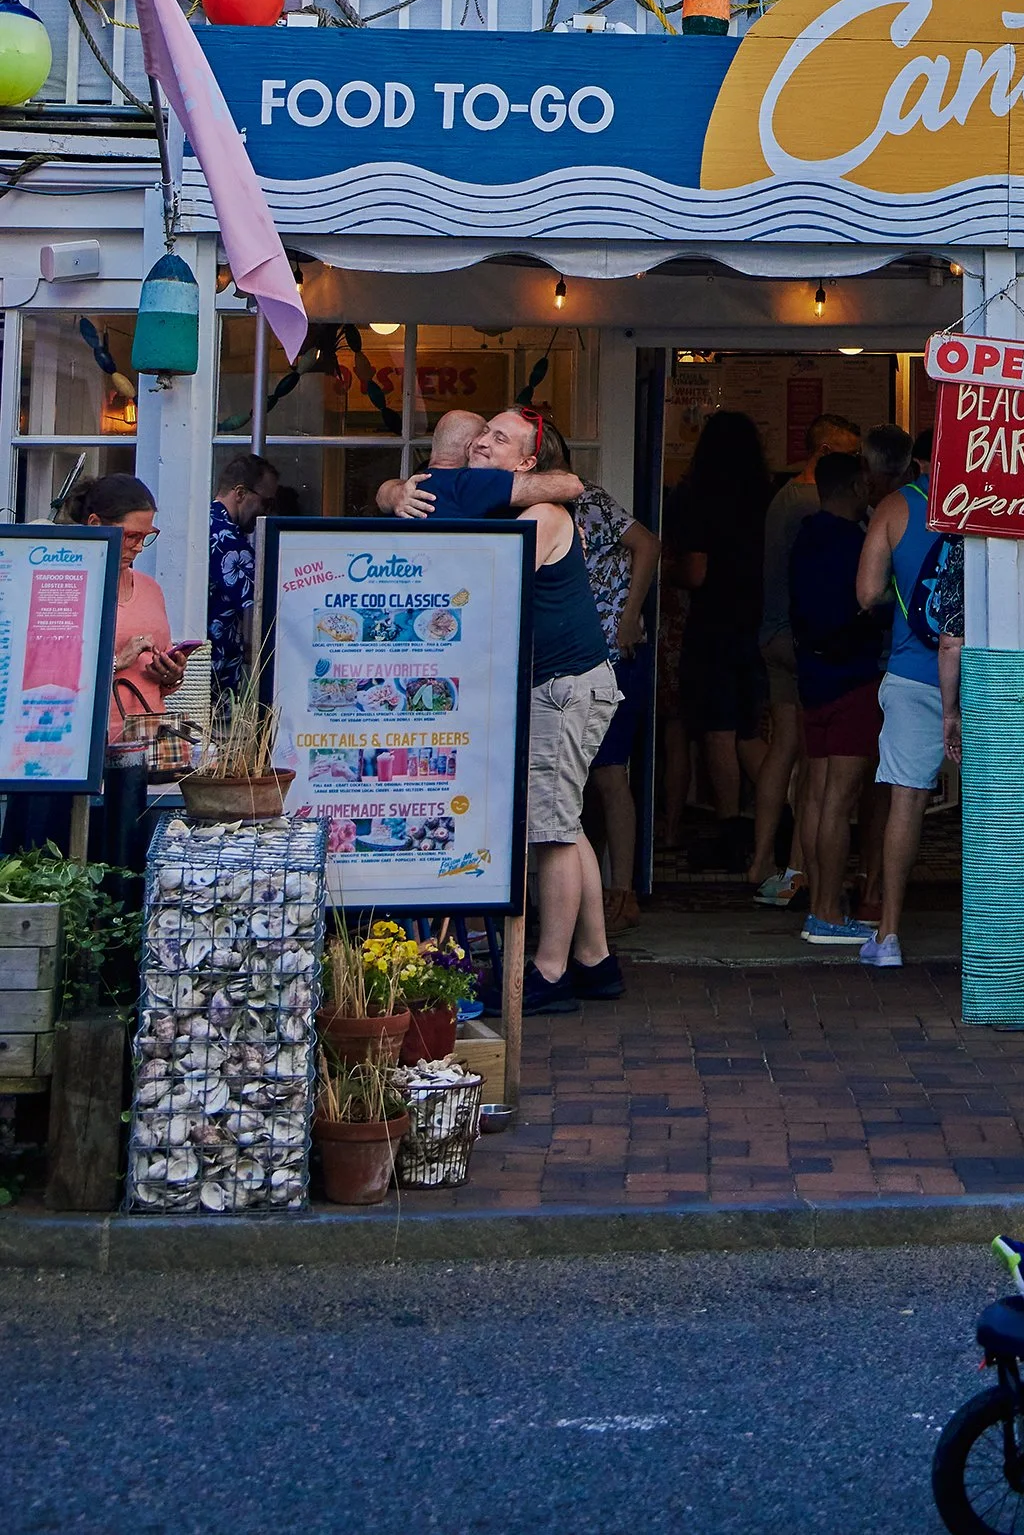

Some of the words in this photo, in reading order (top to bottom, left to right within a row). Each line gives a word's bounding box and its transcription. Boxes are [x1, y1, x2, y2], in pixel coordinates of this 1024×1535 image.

[261, 78, 416, 128] FOOD
[434, 83, 614, 134] TO-GO
[984, 481, 993, 492] is
[29, 546, 83, 565] Canteen
[294, 560, 324, 577] NOW
[348, 553, 423, 583] Canteen
[282, 570, 345, 593] SERVING...
[325, 594, 357, 608] CAPE
[361, 594, 386, 607] COD
[389, 593, 450, 608] CLASSICS
[333, 664, 363, 678] NEW
[366, 663, 439, 677] FAVORITES
[296, 733, 367, 748] COCKTAILS
[371, 733, 381, 747] &
[385, 732, 429, 747] CRAFT
[431, 731, 470, 747] BEERS
[317, 803, 386, 818] HOMEMADE
[388, 802, 445, 817] SWEETS
